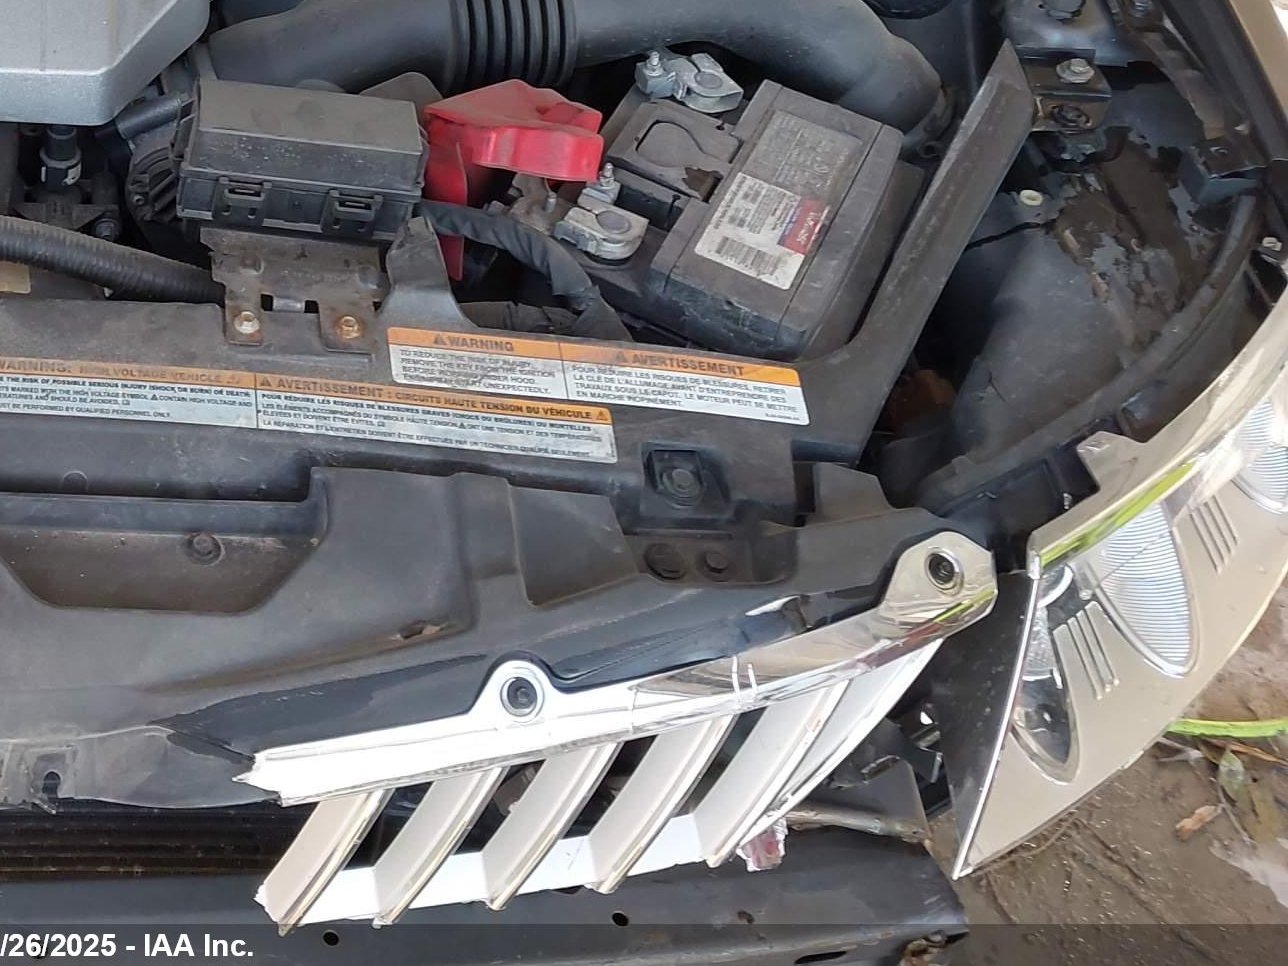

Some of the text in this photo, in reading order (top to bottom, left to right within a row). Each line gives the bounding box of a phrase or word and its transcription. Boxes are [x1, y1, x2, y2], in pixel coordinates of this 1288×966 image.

[447, 335, 514, 351] WARNING
[401, 357, 438, 366] REMOVE
[457, 363, 472, 371] KEY
[631, 353, 745, 376] AVERTISSEMENT
[278, 380, 382, 396] AVERTISSEMENT
[395, 392, 440, 404] CIRCUITS
[444, 397, 476, 408] HAUTE
[479, 401, 523, 412] TENSION
[525, 405, 539, 413] DU
[543, 406, 591, 419] VÉHICULE
[589, 391, 625, 400] MARCHE
[696, 394, 730, 404] MOTEUR
[333, 400, 363, 408] RISQUES
[377, 404, 419, 414] BLESSURES
[421, 409, 449, 417] GRAVES
[549, 422, 591, 431] MORTELLES
